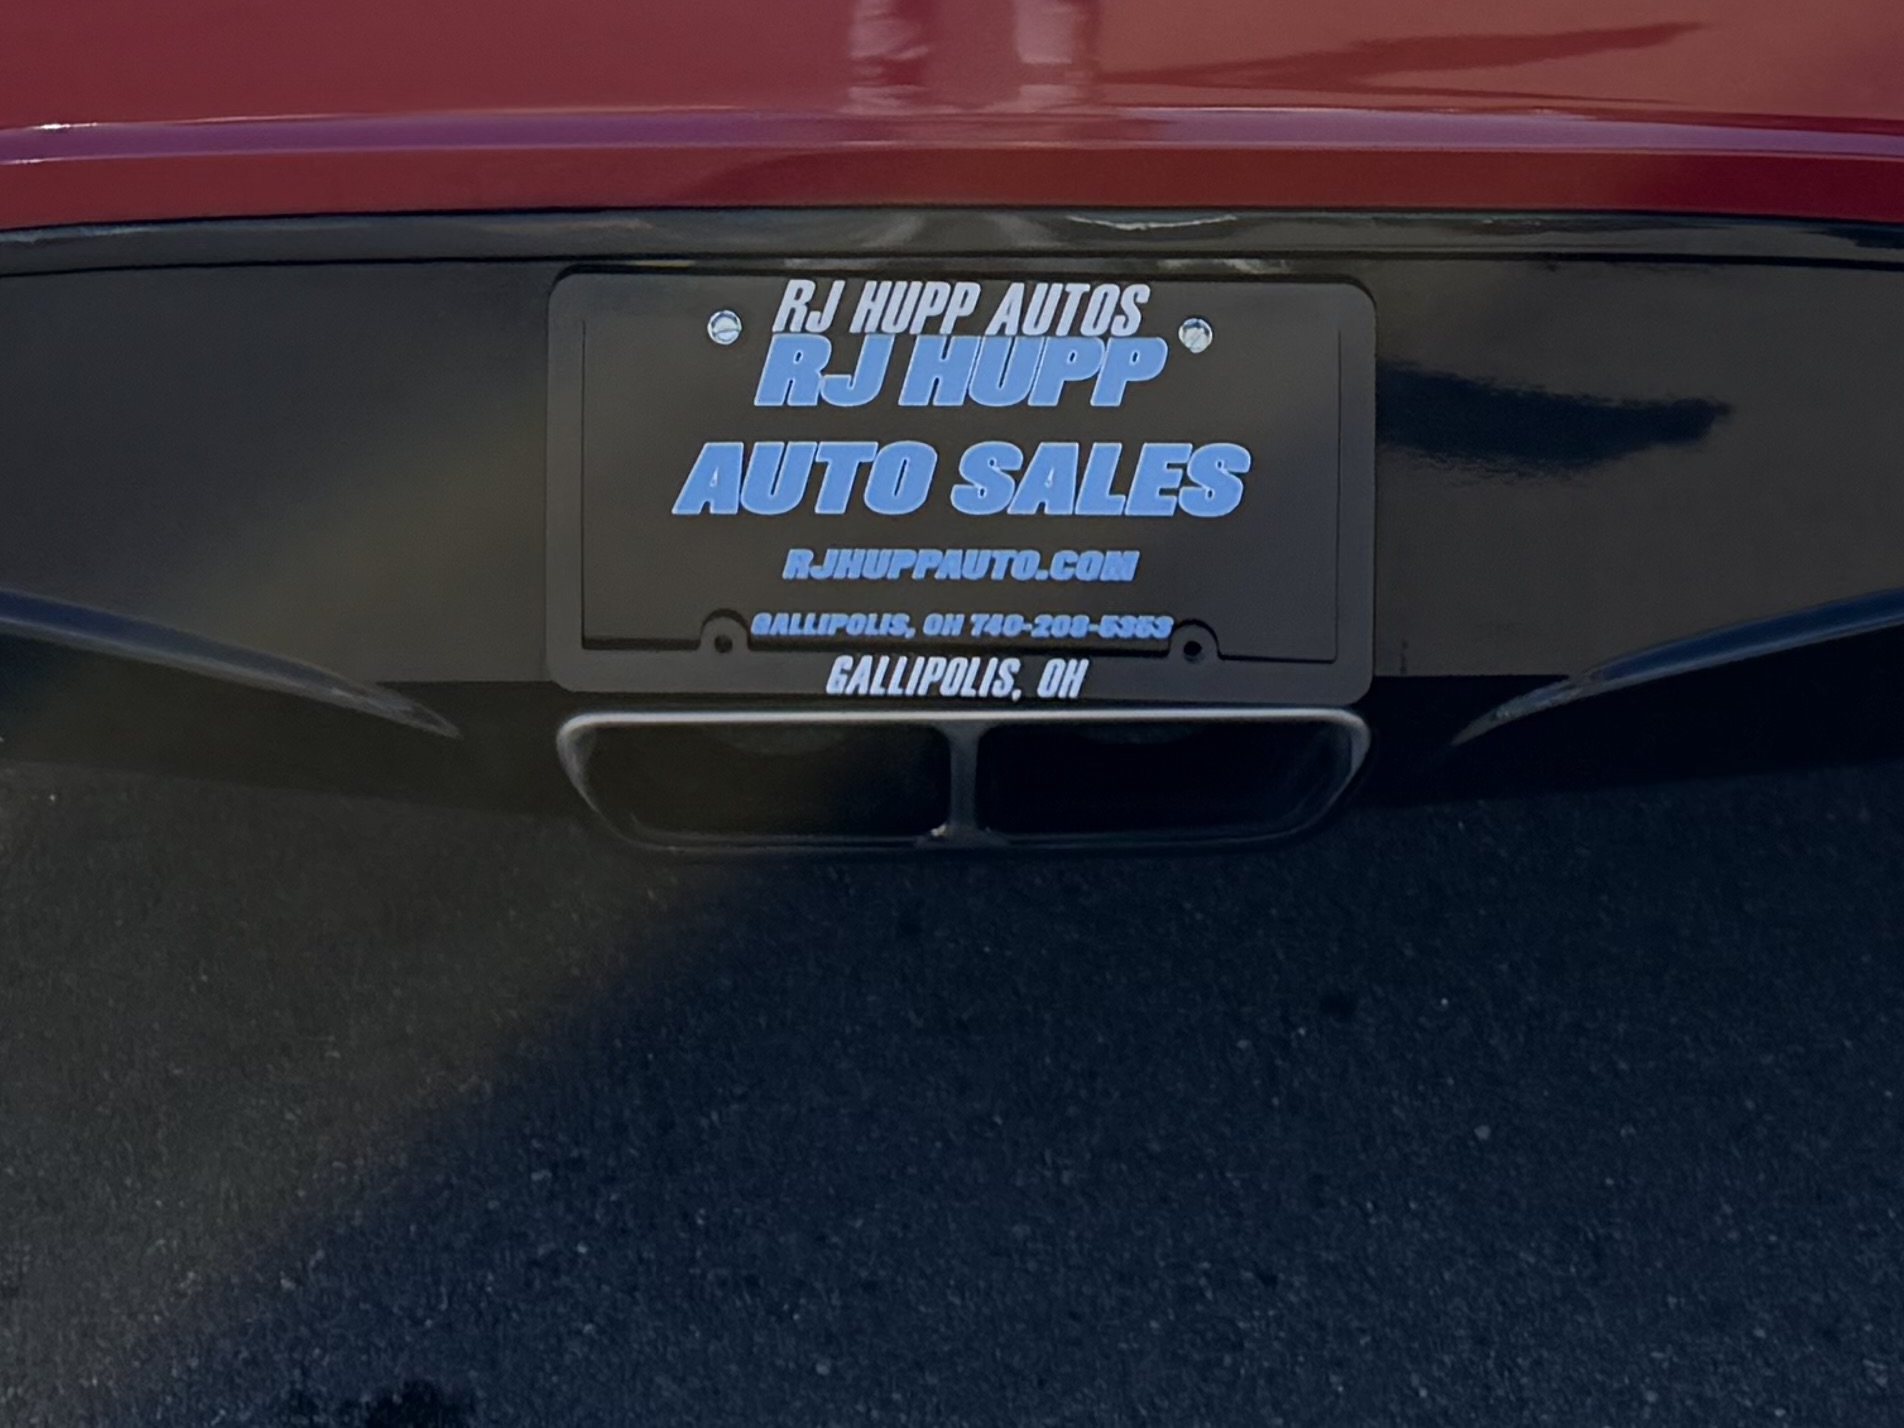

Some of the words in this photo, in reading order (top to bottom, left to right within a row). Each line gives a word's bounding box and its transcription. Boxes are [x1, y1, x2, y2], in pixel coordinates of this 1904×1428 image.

[772, 279, 845, 333] RJ
[849, 280, 982, 335] HUPP
[985, 282, 1151, 337] AUTOS
[753, 333, 895, 407] RJ
[898, 334, 1169, 407] HUPP
[671, 440, 939, 516] AUTO
[950, 440, 1252, 518] SALES
[782, 548, 1140, 582] RJHUPPAUTO.COM
[750, 612, 916, 640] GALLIPOLIS,
[922, 613, 966, 637] OH
[825, 655, 1023, 702] GALLIPOLIS,
[1036, 658, 1090, 699] OH
